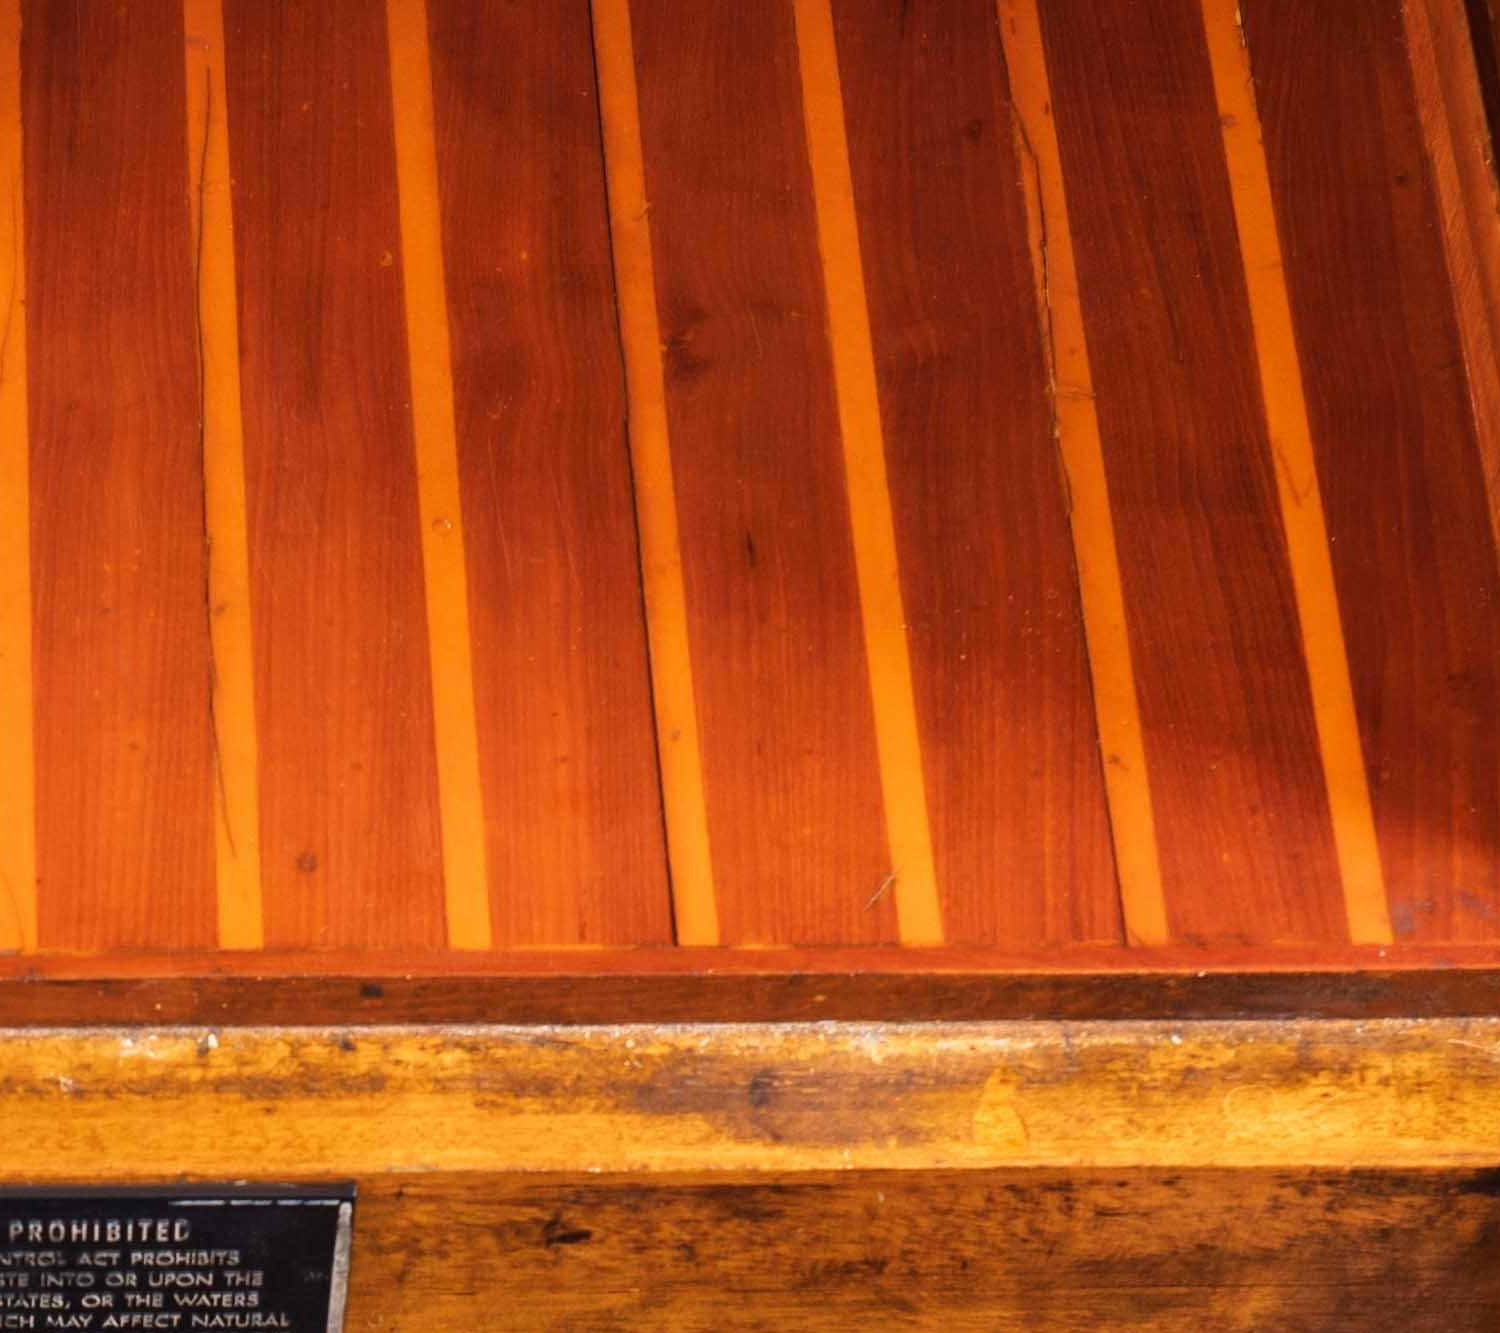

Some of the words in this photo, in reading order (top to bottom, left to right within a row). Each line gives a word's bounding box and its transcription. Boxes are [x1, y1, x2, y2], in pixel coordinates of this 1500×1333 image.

[8, 1218, 191, 1242] PROHIBITED
[78, 1251, 121, 1267] ACT
[130, 1250, 241, 1267] PROHIBITS
[40, 1271, 95, 1288] INTO
[105, 1271, 138, 1288] OR
[148, 1271, 214, 1287] UPON
[223, 1270, 265, 1287] THE
[80, 1293, 114, 1309] OR
[124, 1292, 164, 1308] THE
[173, 1292, 260, 1308] WATERS
[46, 1314, 93, 1329] MAY
[102, 1313, 182, 1329] AFFECT
[191, 1312, 291, 1328] NATURAL
